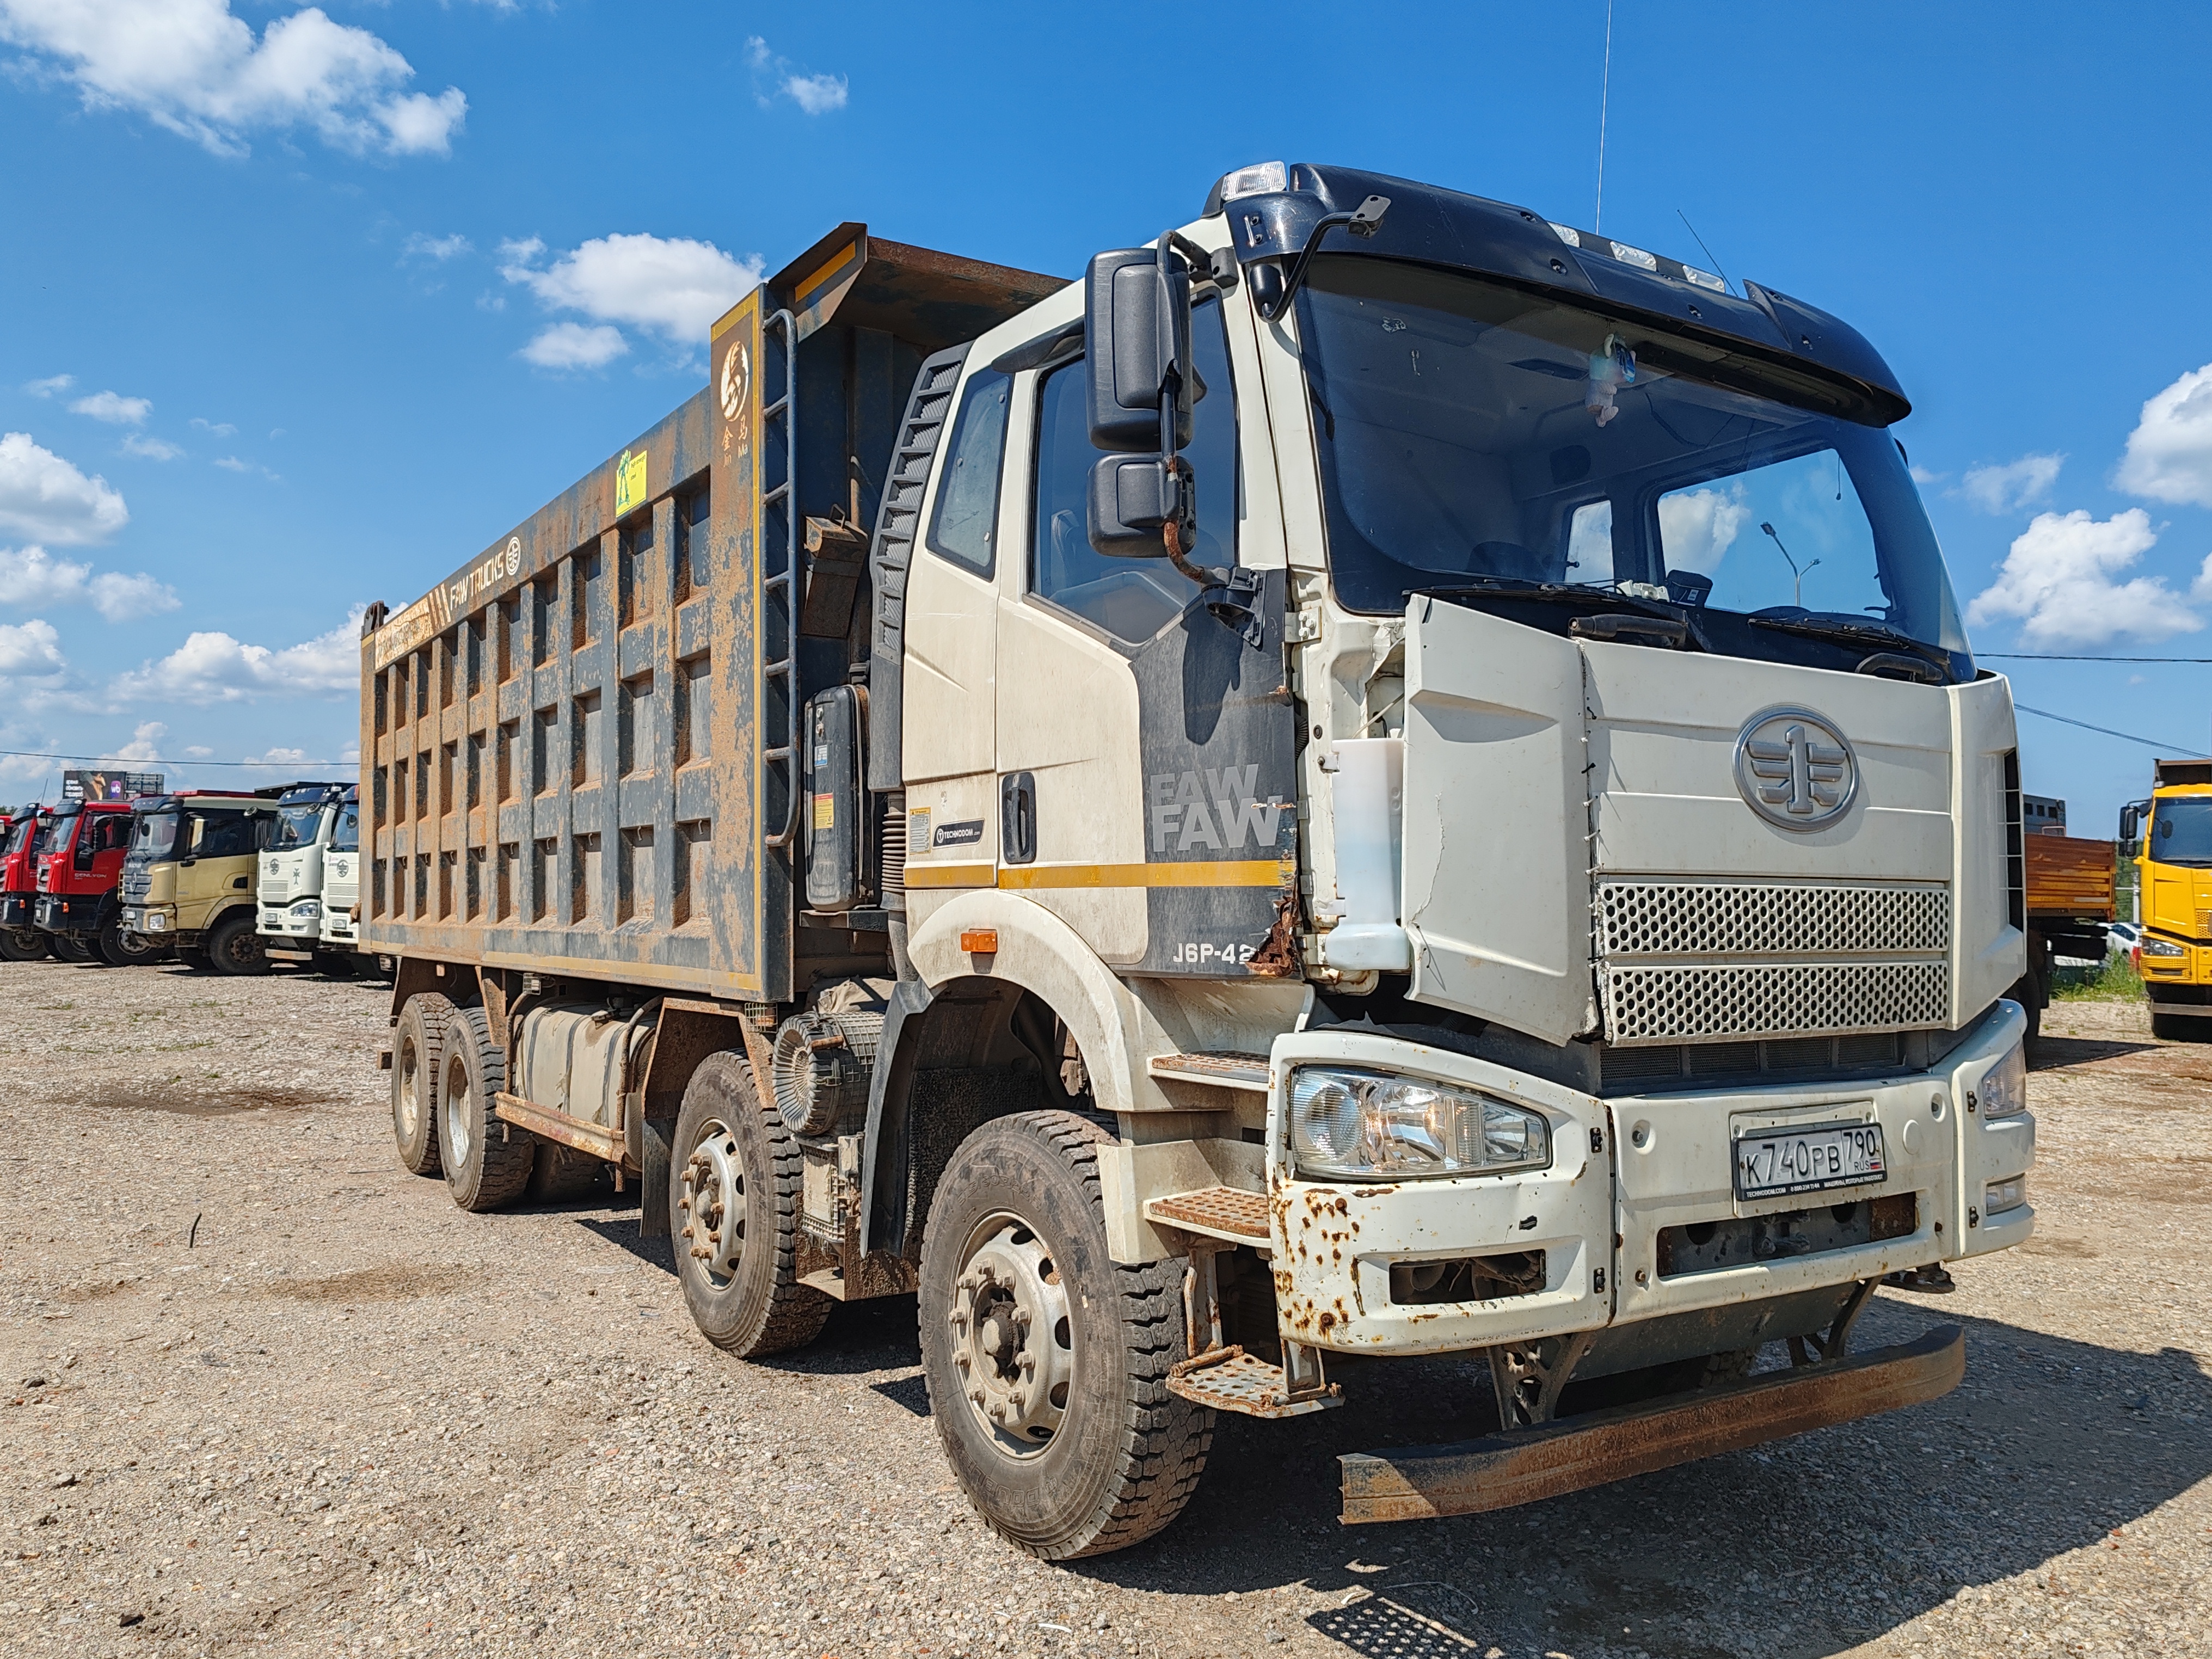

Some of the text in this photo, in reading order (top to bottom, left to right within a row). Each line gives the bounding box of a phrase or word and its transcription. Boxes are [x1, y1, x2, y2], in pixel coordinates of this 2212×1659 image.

[723, 444, 748, 468] Jin Ma
[450, 551, 504, 611] FAW TRUCKS
[111, 784, 120, 793] wb
[1150, 764, 1259, 809] FAW
[1152, 795, 1283, 852] FAW
[1843, 1129, 1876, 1160] 790
[1854, 1160, 1870, 1172] RUS
[1746, 1187, 1786, 1197] TECHNODOM.COM
